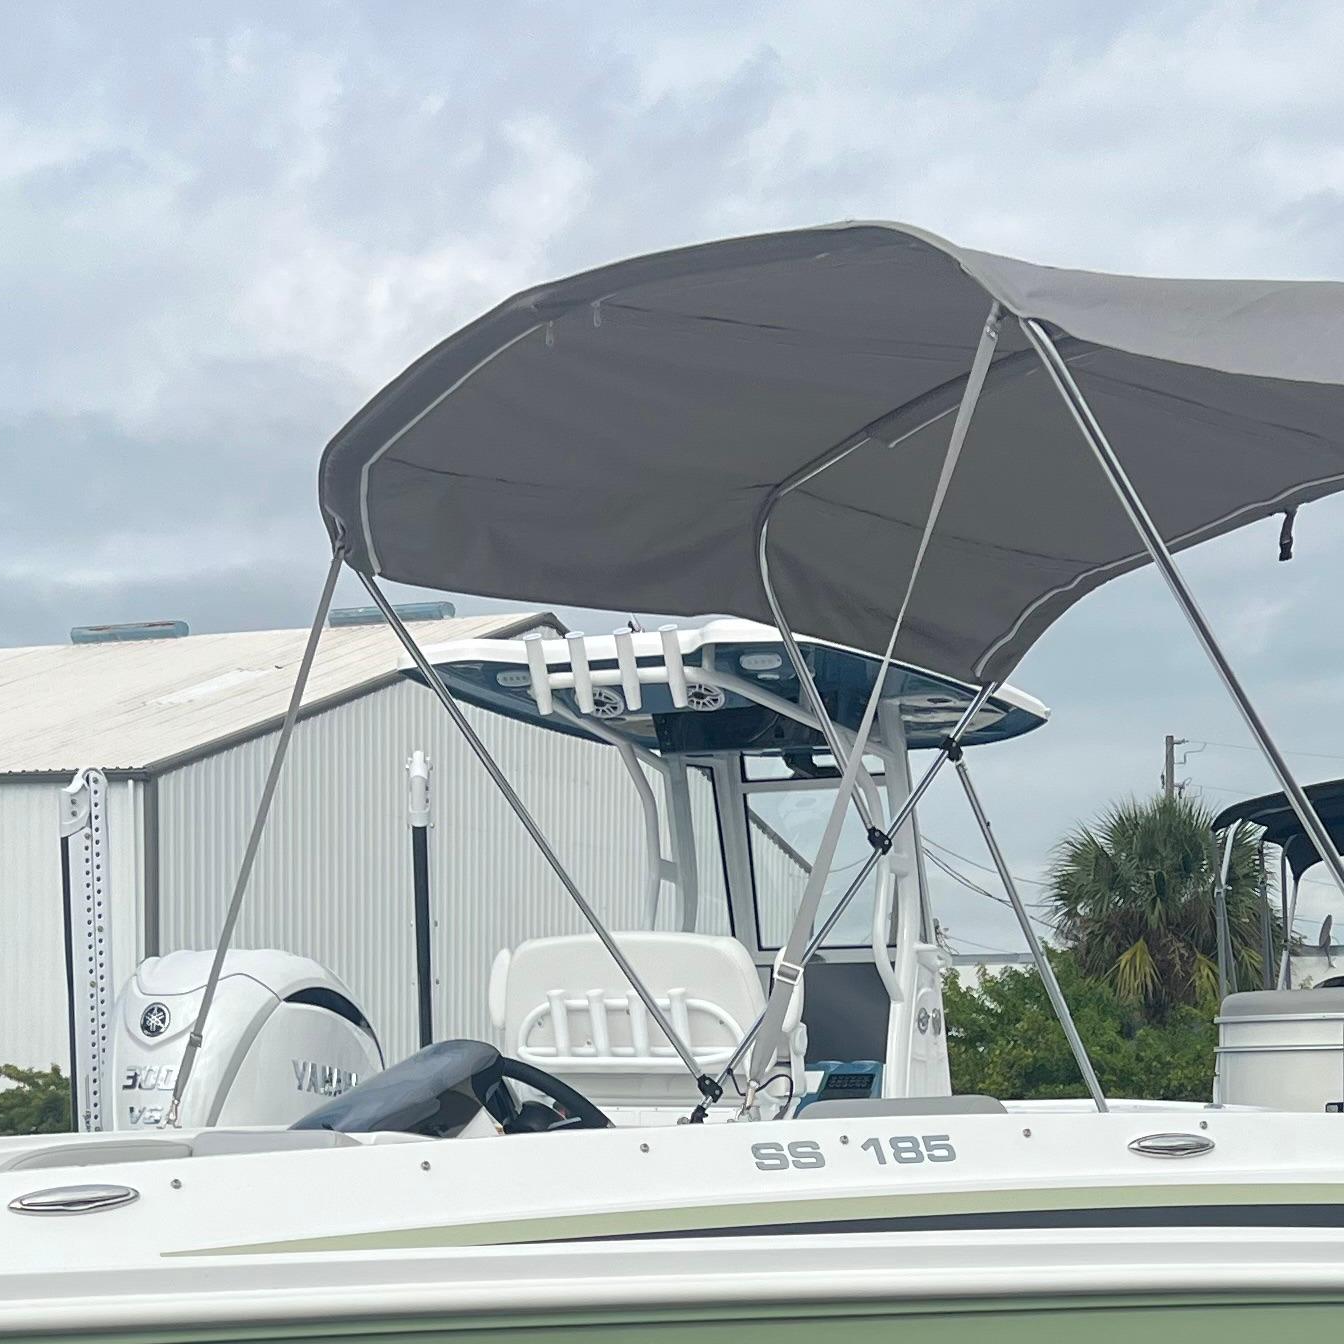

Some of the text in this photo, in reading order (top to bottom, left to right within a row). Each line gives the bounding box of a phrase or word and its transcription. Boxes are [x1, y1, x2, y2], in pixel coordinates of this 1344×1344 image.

[122, 1064, 179, 1091] 300
[291, 1059, 359, 1097] YAMAH
[751, 1134, 957, 1171] SS 185
